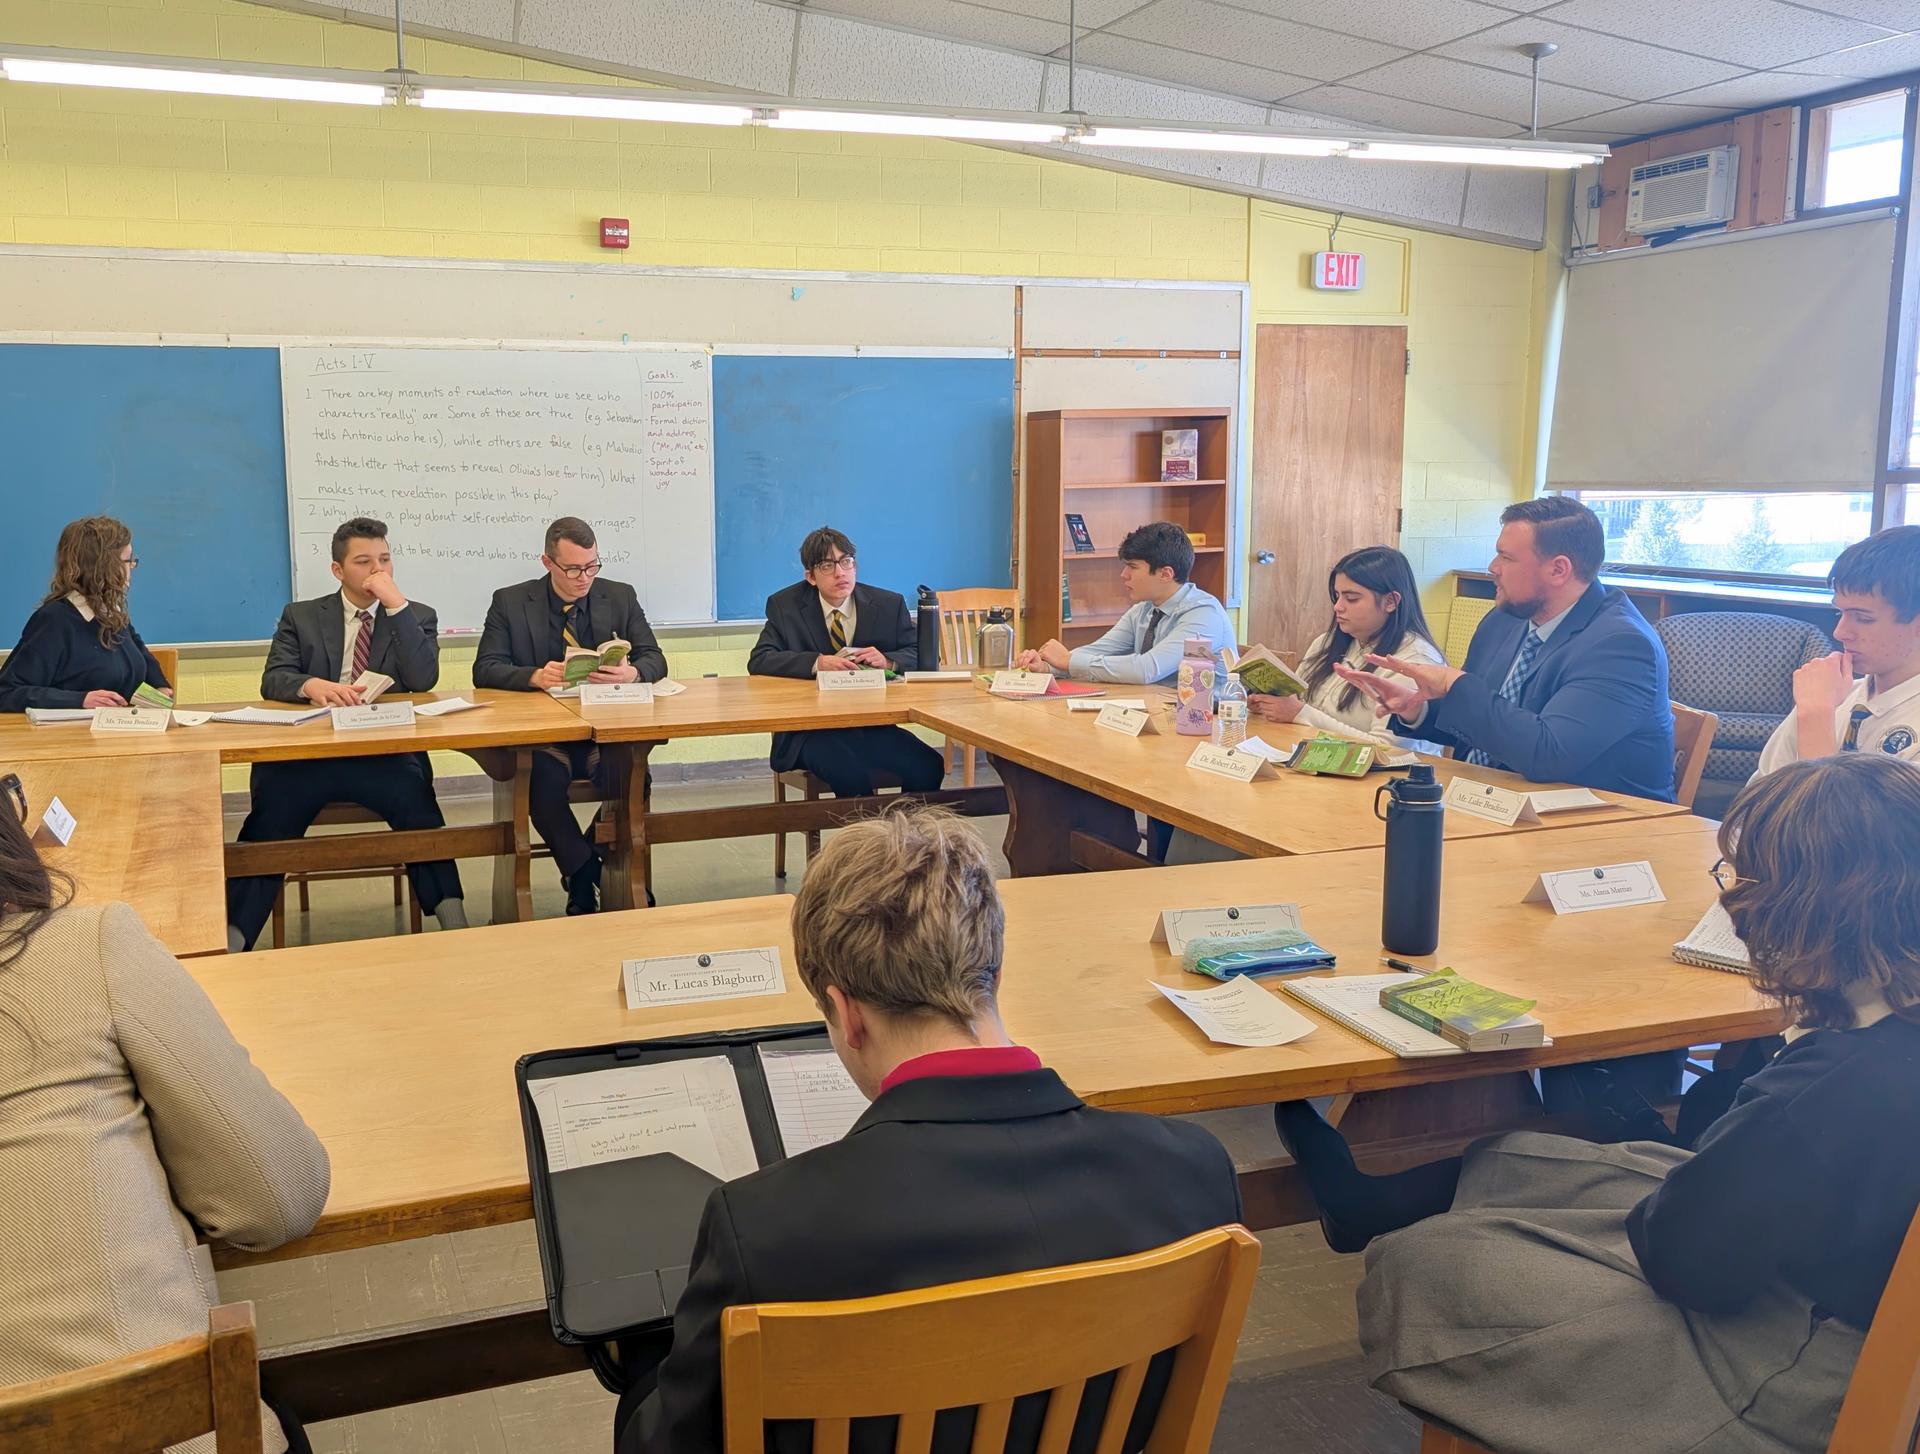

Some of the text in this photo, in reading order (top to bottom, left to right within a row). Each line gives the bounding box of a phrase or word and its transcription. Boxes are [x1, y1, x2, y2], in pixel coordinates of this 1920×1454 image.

[1325, 253, 1360, 286] EXIT
[316, 357, 346, 371] Acts
[321, 388, 352, 399] There
[377, 387, 393, 404] key
[399, 387, 444, 398] moments
[448, 386, 460, 397] of
[466, 387, 512, 397] revelation
[520, 387, 549, 398] where
[554, 391, 569, 400] we
[575, 392, 593, 401] see
[597, 391, 621, 402] who
[319, 408, 375, 419] characters
[448, 405, 476, 419] Some
[480, 407, 491, 418] of
[496, 407, 522, 418] these
[525, 410, 542, 418] are
[606, 410, 642, 425] Sebastian
[651, 401, 702, 413] participation
[650, 415, 707, 425] Formal diction
[312, 427, 336, 440] tells
[342, 428, 382, 442] Antonio
[386, 431, 409, 443] who
[413, 431, 425, 443] he
[454, 434, 481, 447] while
[488, 435, 522, 448] others
[524, 440, 544, 448] are
[550, 434, 573, 449] false
[647, 428, 697, 438] and address
[314, 452, 339, 468] finds
[340, 457, 357, 469] the
[361, 457, 388, 470] letter
[393, 459, 420, 473] that
[424, 463, 456, 473] seems
[460, 462, 470, 473] to
[472, 463, 504, 474] reveal
[509, 463, 541, 478] Olivia's
[544, 464, 560, 478] love
[563, 465, 578, 479] for
[610, 467, 636, 485] What
[649, 456, 685, 468] Spirit of
[649, 468, 697, 477] wonder and
[656, 478, 670, 489] joy
[318, 482, 559, 507] makes true revelation possible in this play?
[323, 506, 348, 523] Why
[353, 506, 378, 518] does
[385, 511, 395, 520] a
[399, 509, 421, 527] play
[425, 510, 456, 522] about
[462, 512, 534, 524] self-revelation
[585, 517, 636, 532] arriages?
[406, 544, 416, 555] to
[421, 544, 433, 557] be
[437, 548, 460, 559] wise
[465, 547, 484, 558] and
[488, 549, 506, 560] who
[509, 550, 518, 561] is
[598, 550, 630, 564] oolish?
[649, 973, 765, 993] Mr. Lucas Blagburn
[1501, 1033, 1510, 1046] 17
